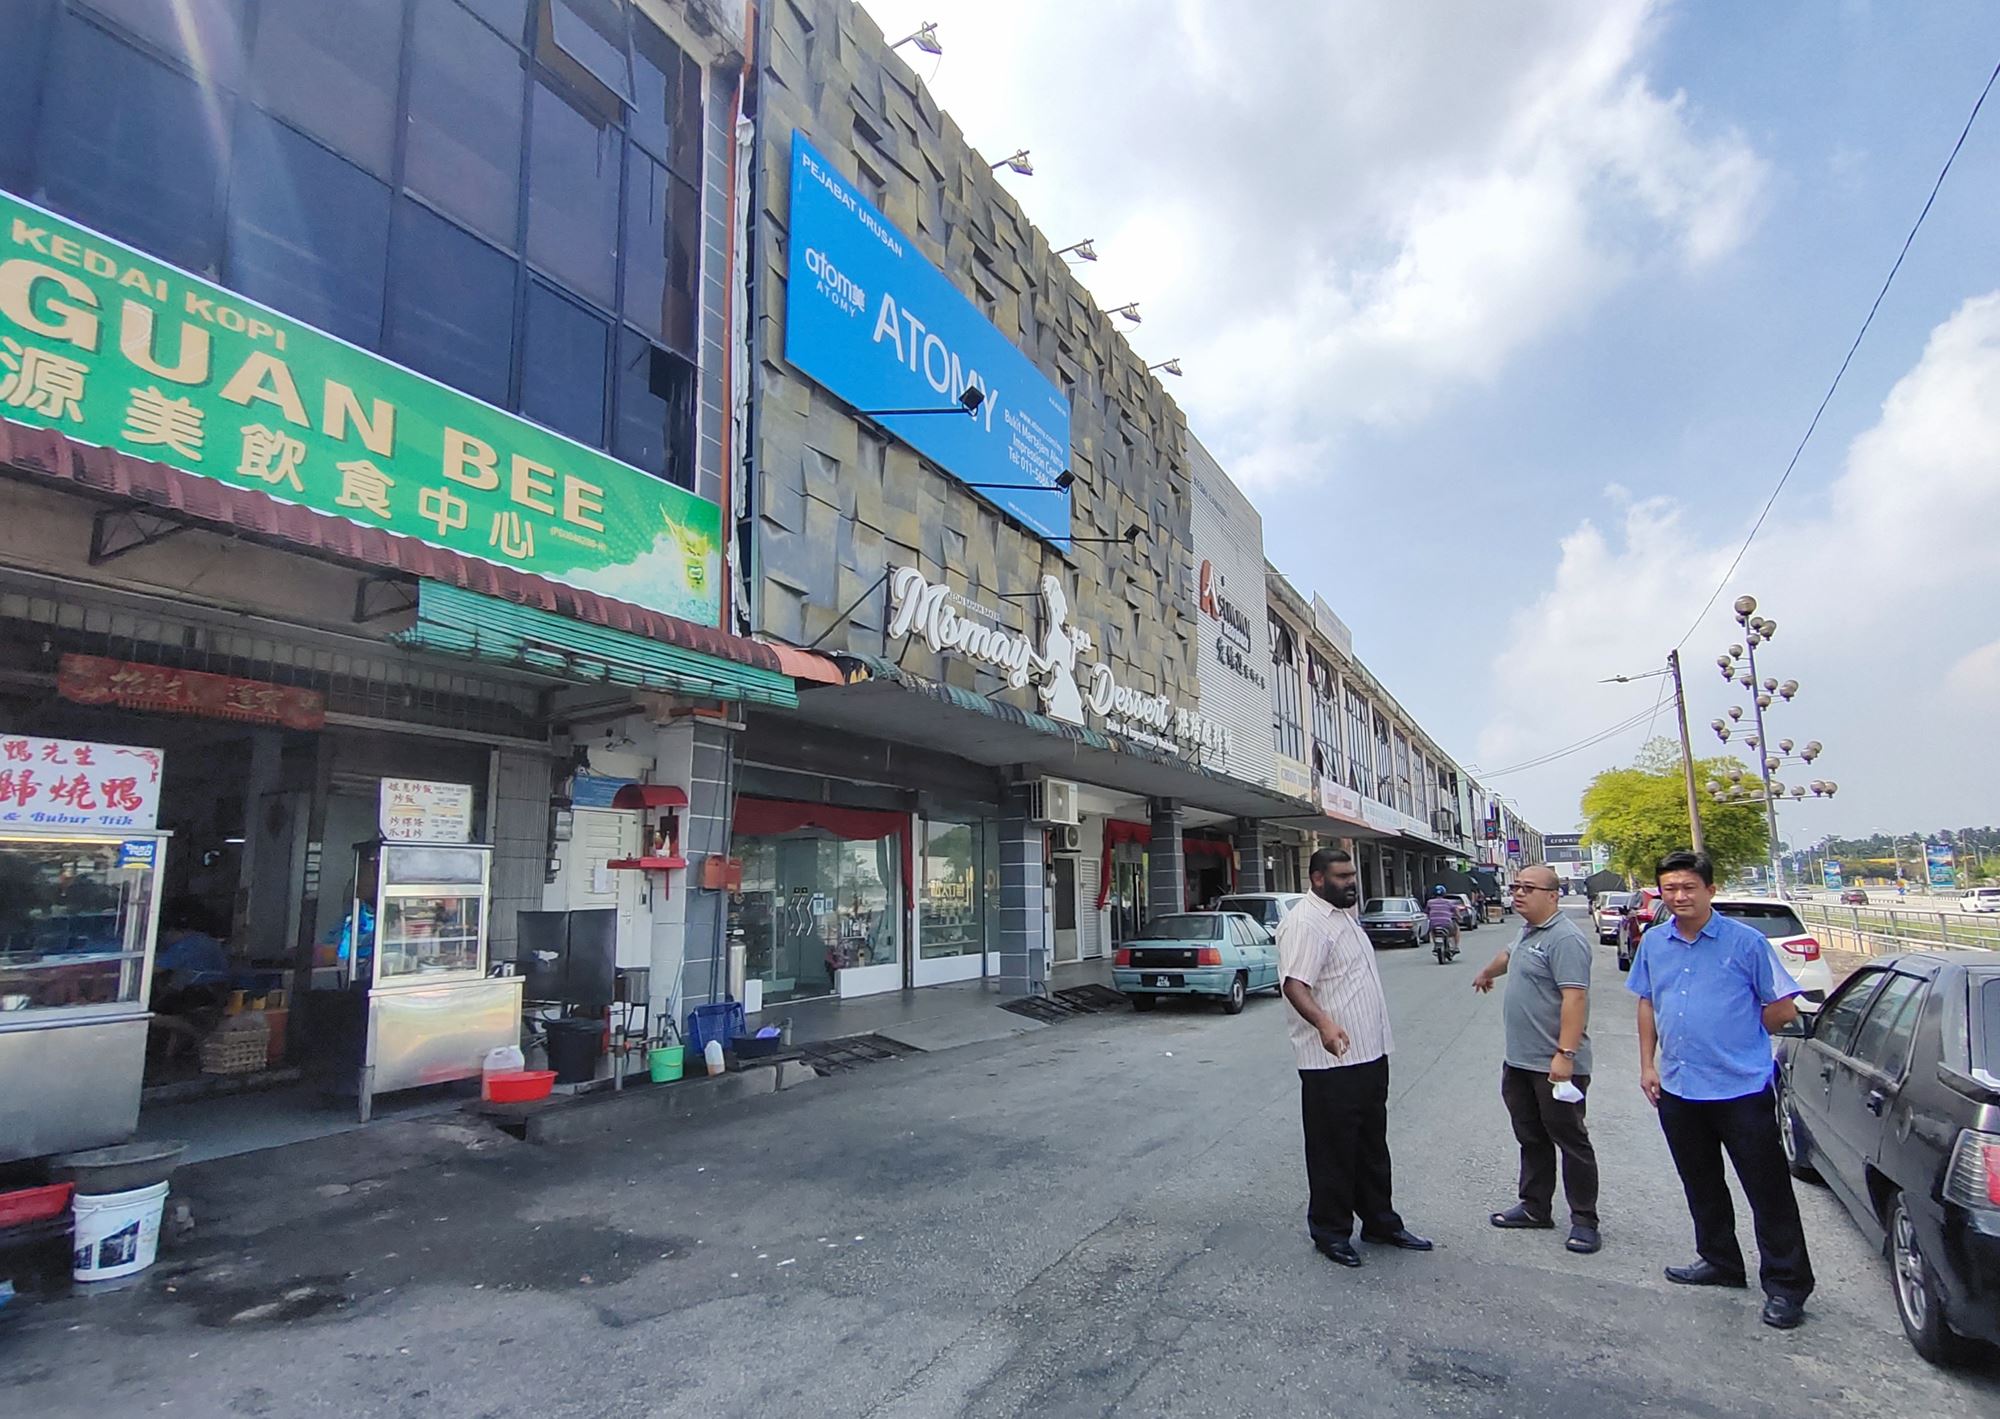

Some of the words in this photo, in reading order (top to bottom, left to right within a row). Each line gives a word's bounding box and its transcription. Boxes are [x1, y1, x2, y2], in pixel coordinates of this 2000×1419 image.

[802, 153, 856, 212] PEJABAT
[858, 208, 902, 258] URUSAN
[12, 218, 168, 301] KEDAI
[184, 292, 286, 351] KOPI
[817, 281, 856, 318] ATOMY
[0, 258, 395, 457] GUAN
[442, 427, 605, 533] BEE
[871, 292, 999, 433] ATOMY
[1085, 662, 1170, 730] Dessert
[30, 811, 91, 825] Bubur
